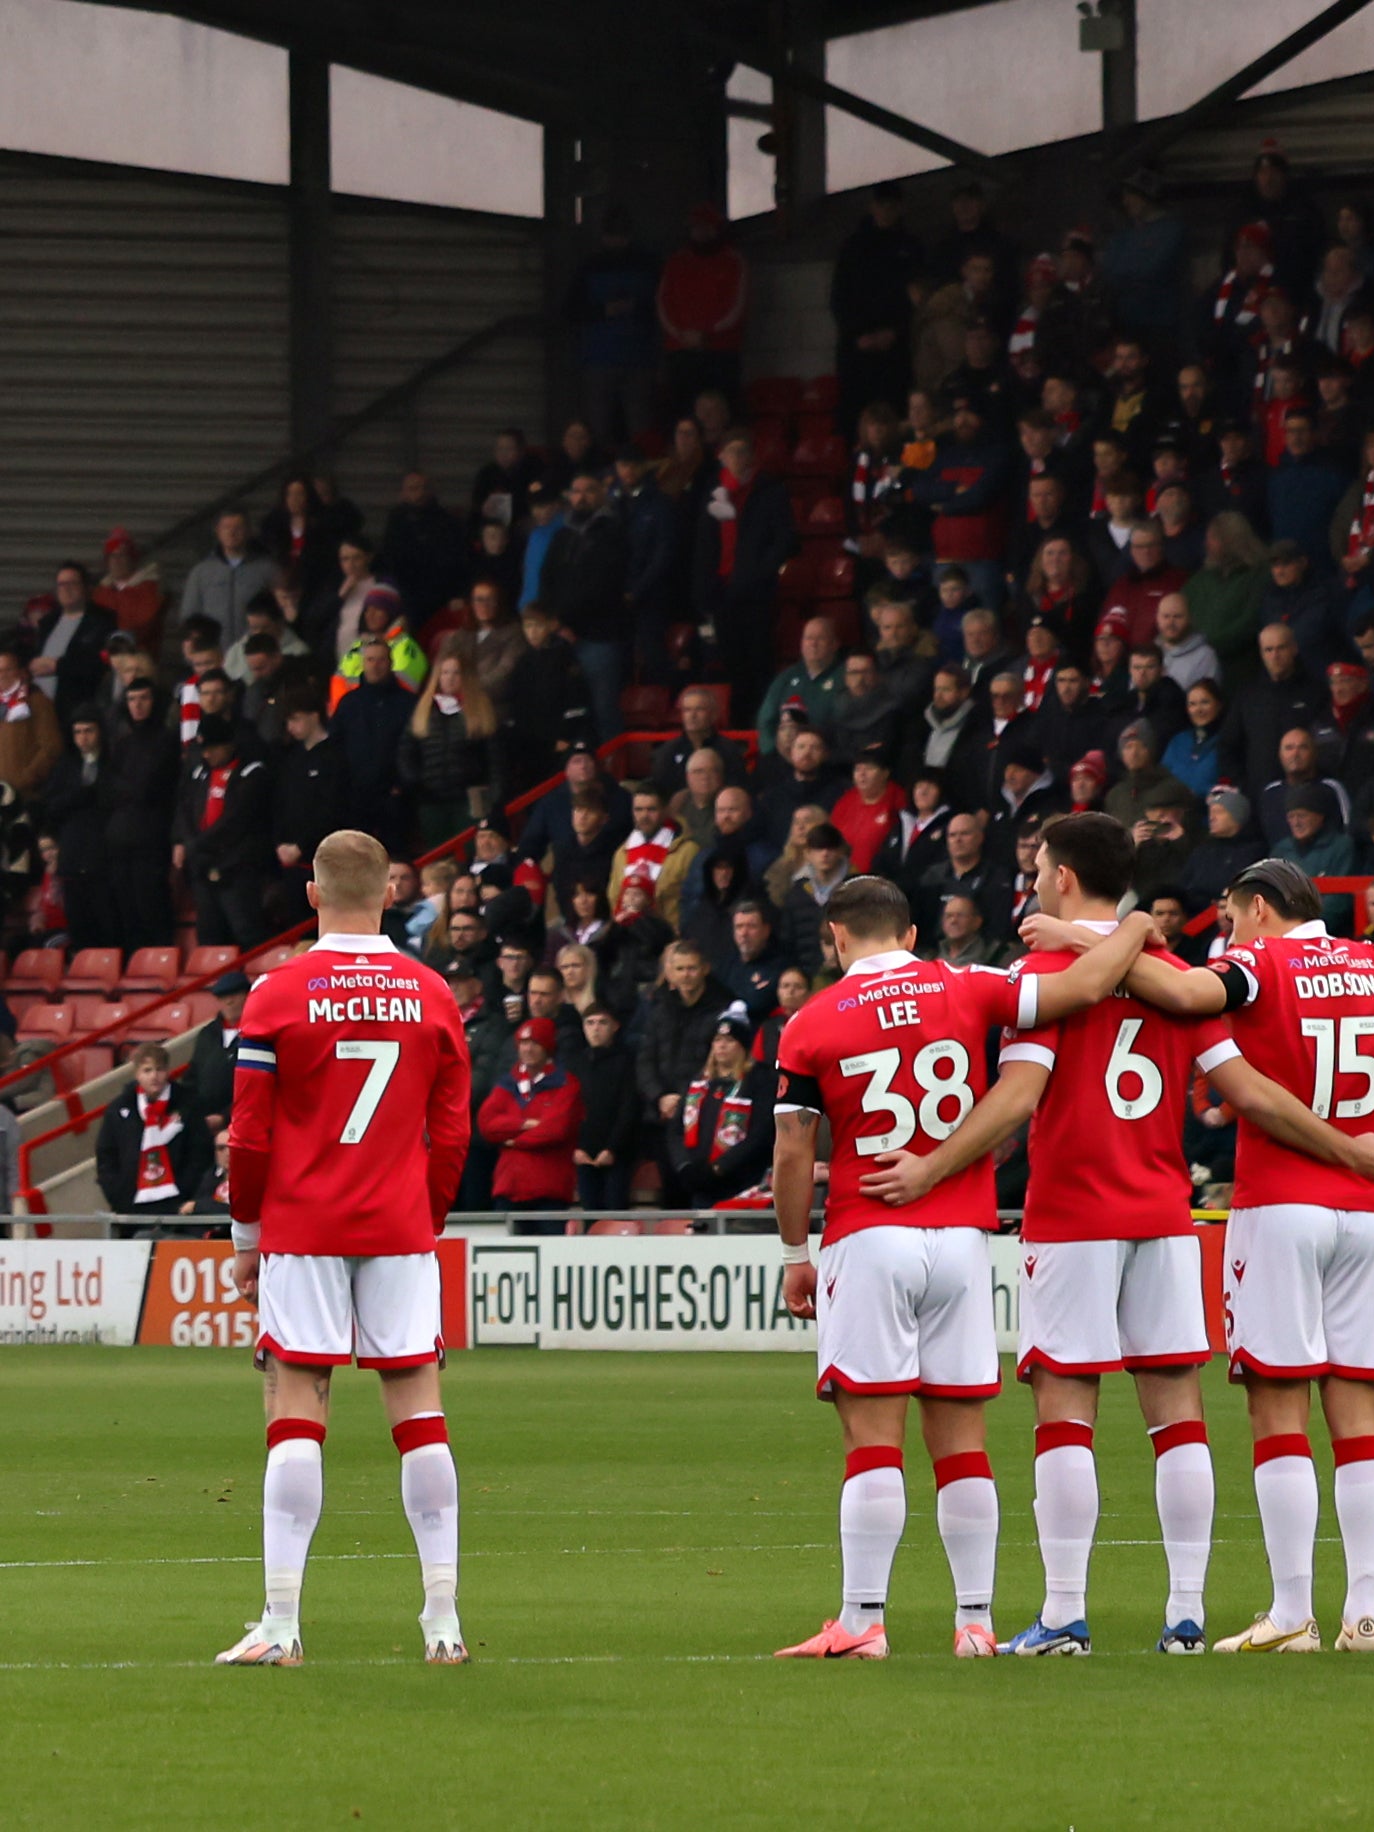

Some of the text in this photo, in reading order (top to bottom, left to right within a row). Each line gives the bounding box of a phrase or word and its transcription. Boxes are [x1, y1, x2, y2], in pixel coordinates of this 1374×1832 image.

[1303, 954, 1346, 969] Meta
[331, 974, 420, 990] Meta Quest
[858, 985, 900, 1005] Meta
[308, 996, 422, 1023] McCLEAN
[876, 1000, 921, 1030] LEE
[1105, 1018, 1163, 1120] 6
[336, 1040, 400, 1144] 7
[839, 1038, 975, 1156] 38
[56, 1257, 103, 1307] Ltd
[552, 1264, 808, 1331] HUGHES:O'HA
[171, 1311, 259, 1347] 6615
